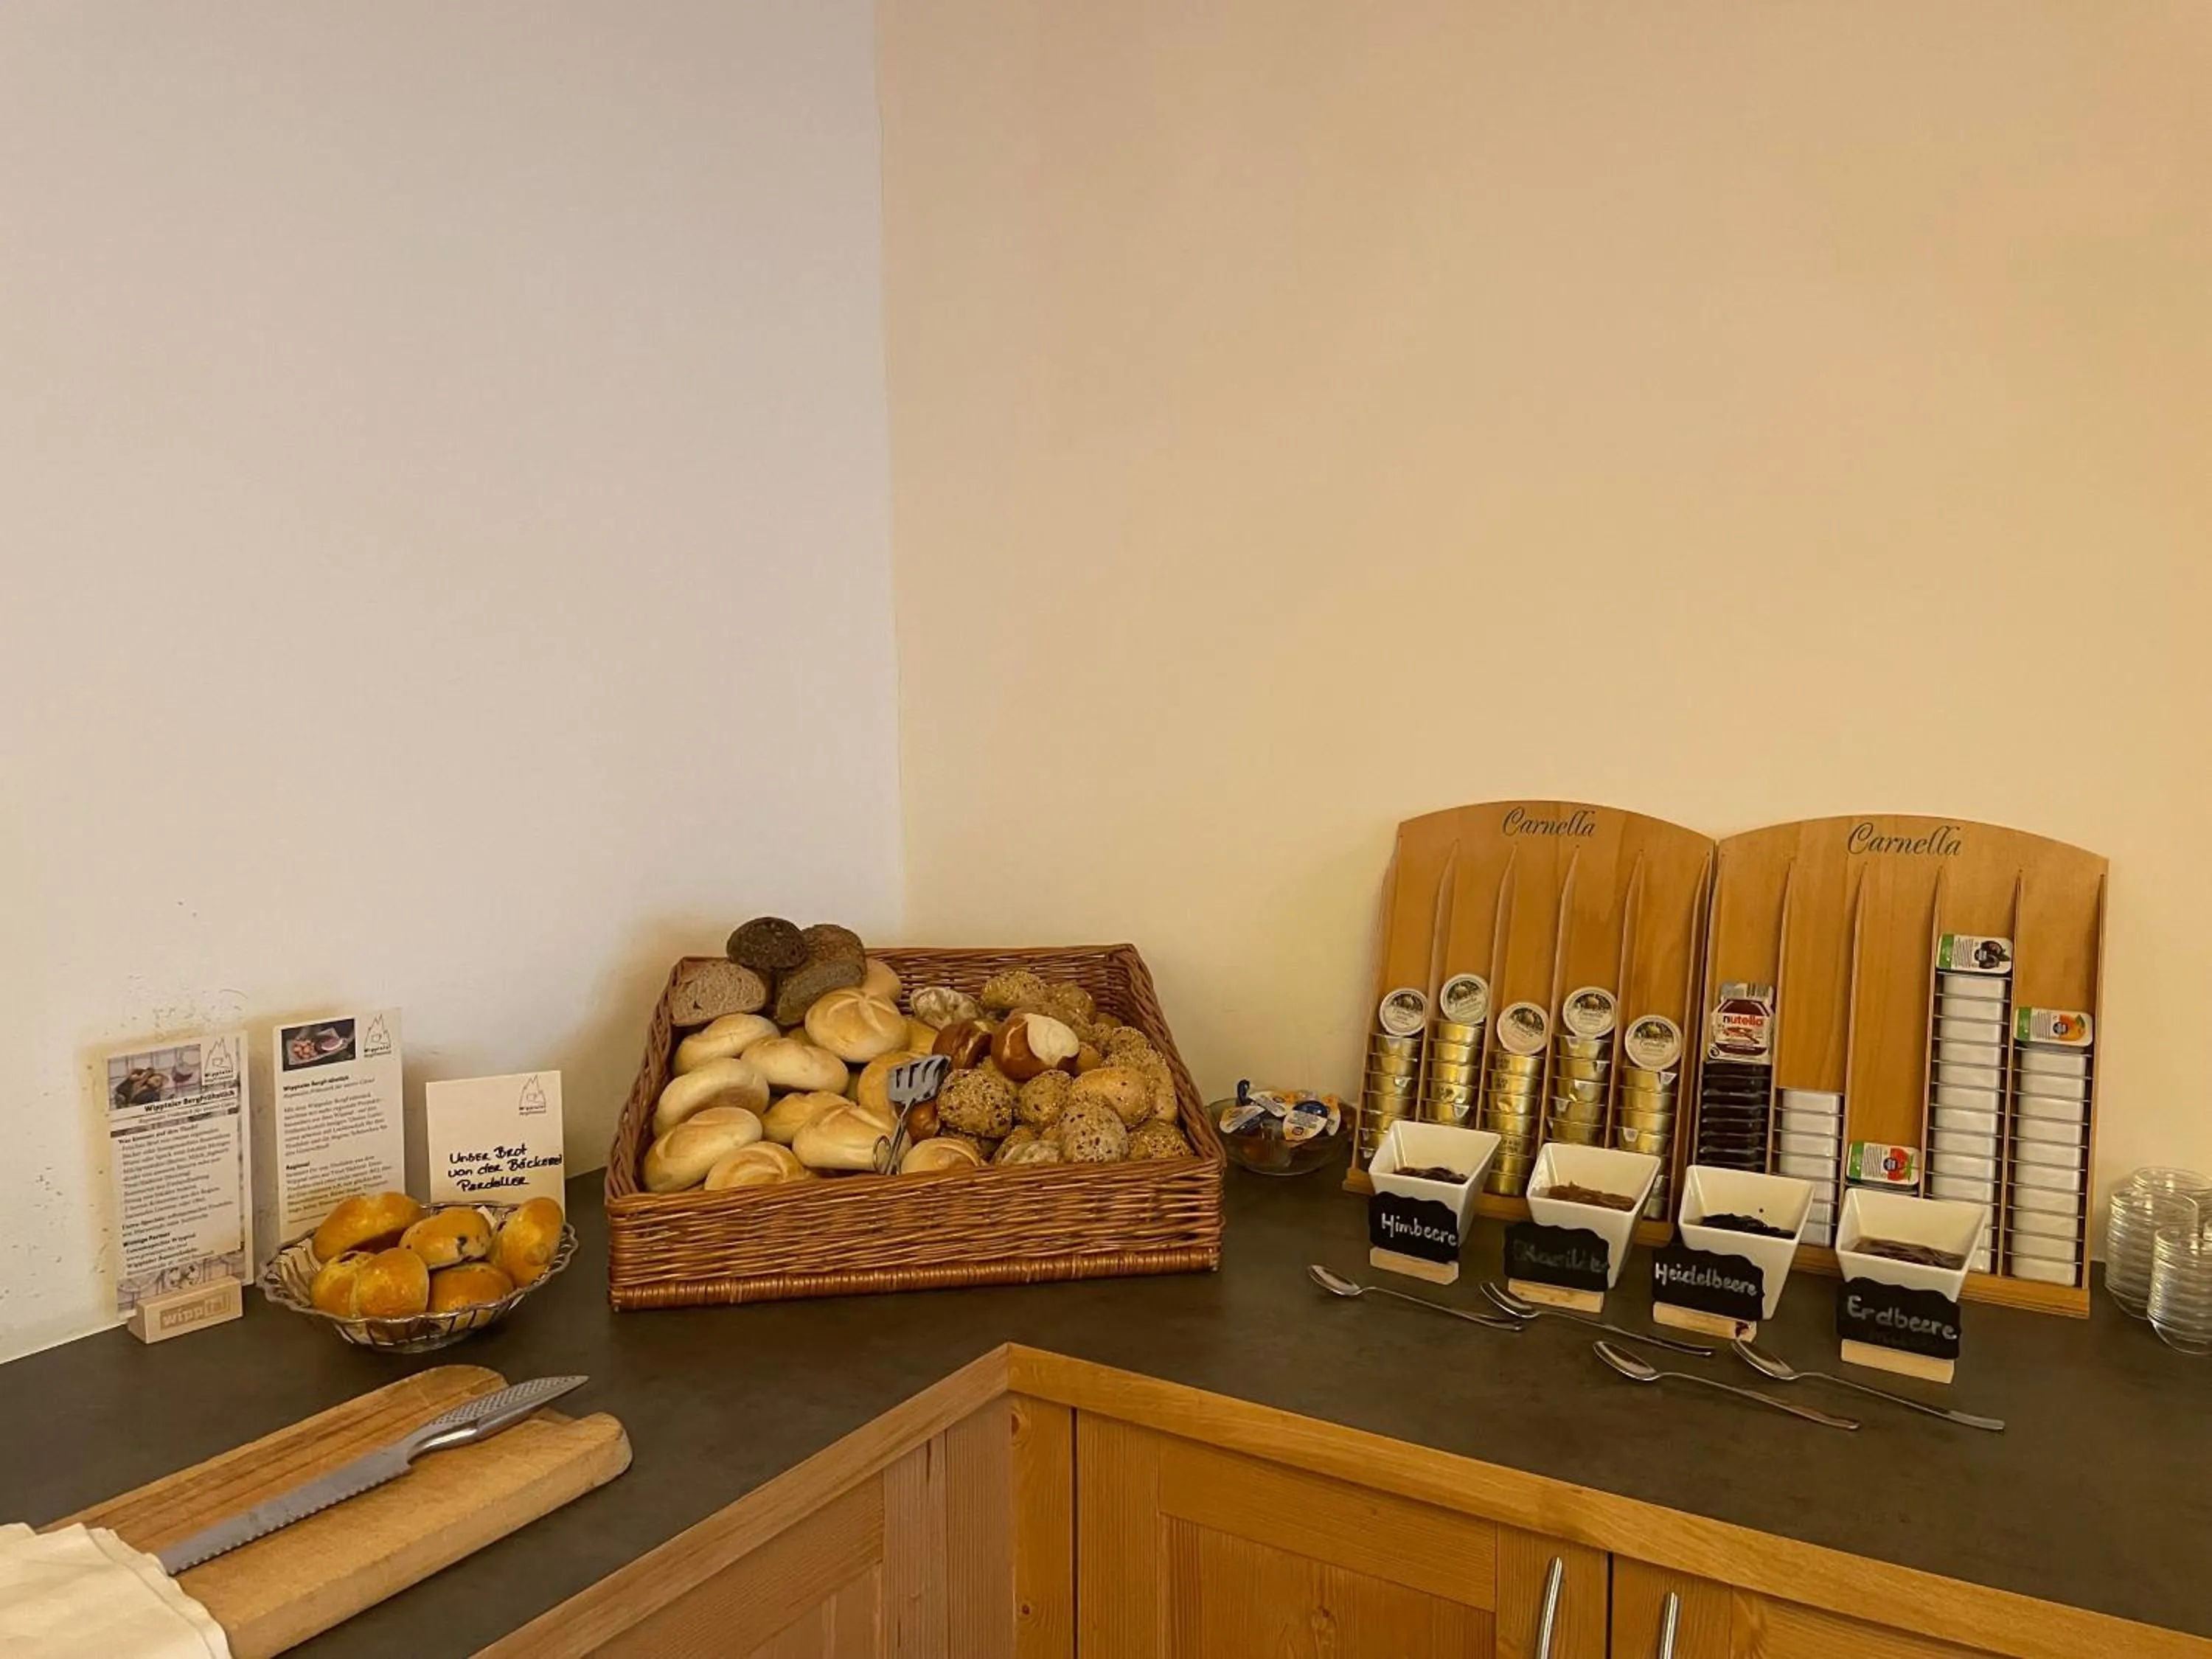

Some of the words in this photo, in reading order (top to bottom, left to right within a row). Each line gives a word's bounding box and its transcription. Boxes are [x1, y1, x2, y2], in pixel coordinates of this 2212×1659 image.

[1503, 805, 1596, 837] Carnella
[1847, 822, 1961, 856] Carnella
[1723, 1015, 1764, 1027] nutella
[1381, 1212, 1458, 1247] Himbeere
[1654, 1262, 1759, 1297] Heidelbeere
[1846, 1294, 1958, 1340] Erdbeere
